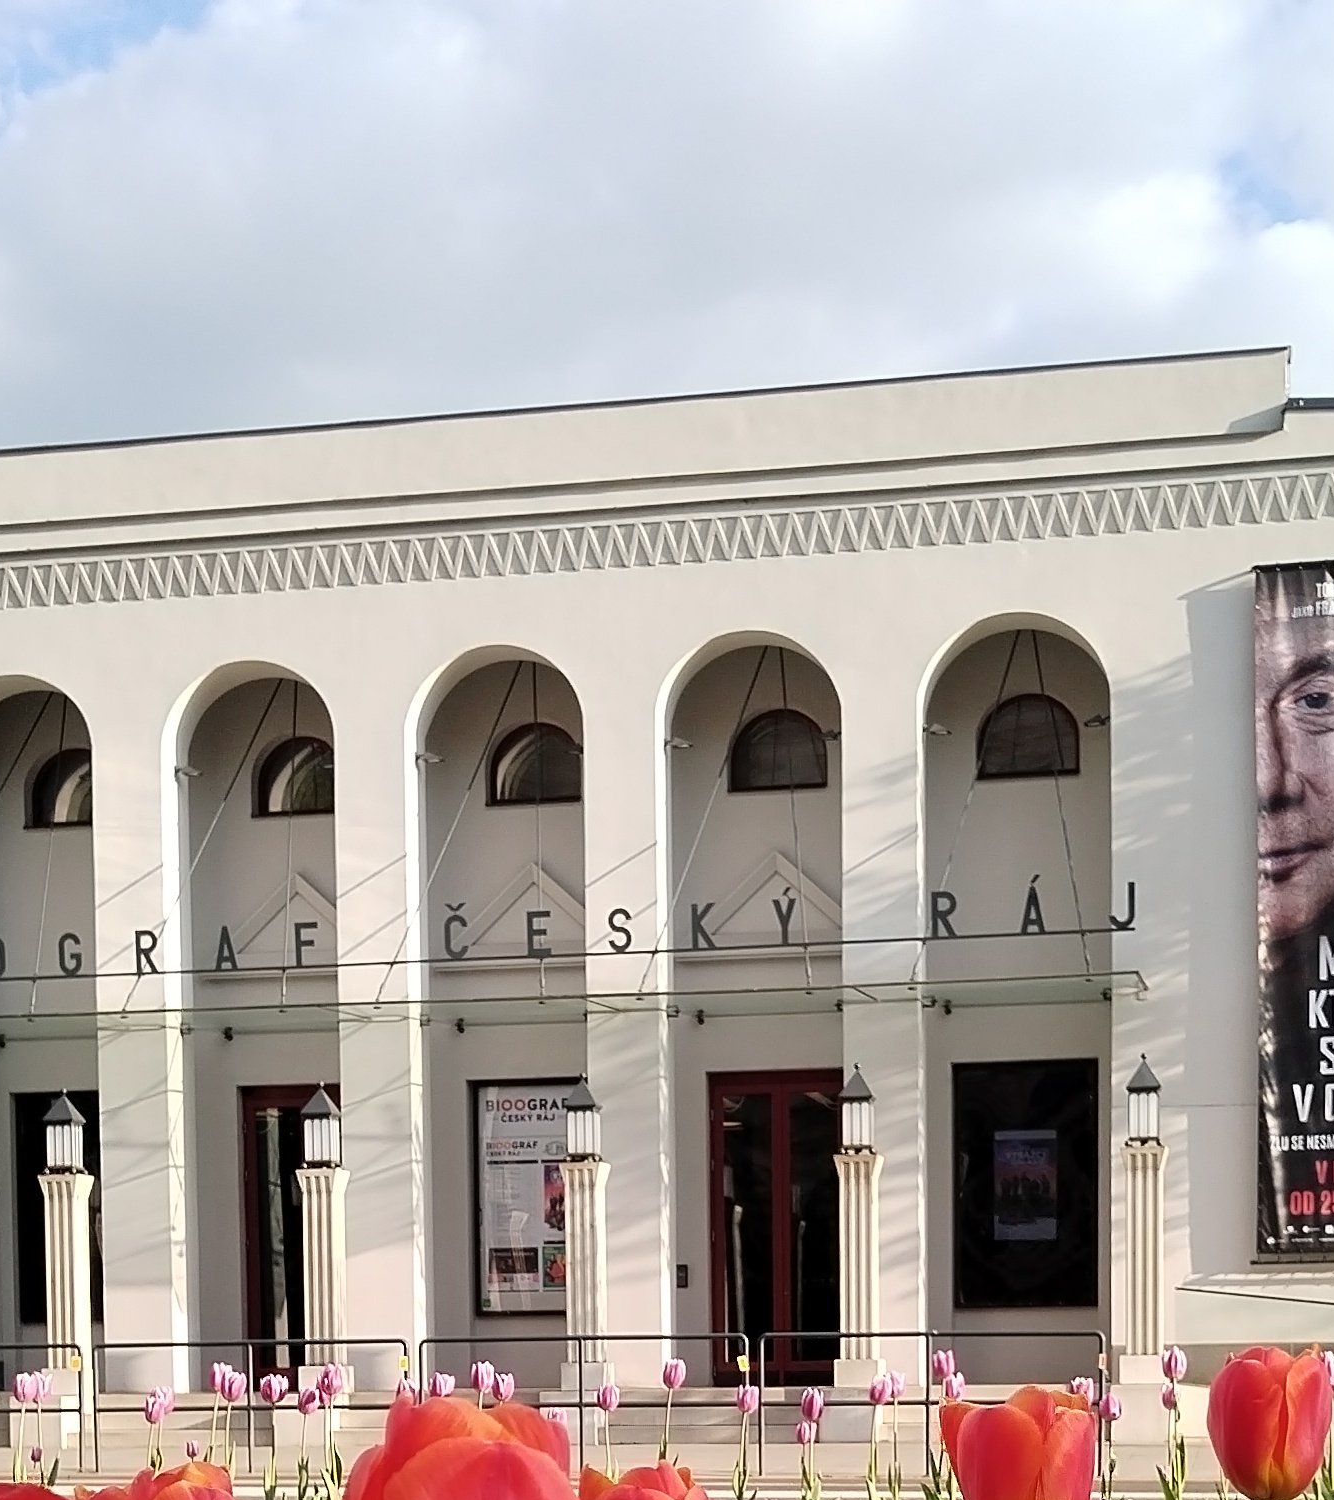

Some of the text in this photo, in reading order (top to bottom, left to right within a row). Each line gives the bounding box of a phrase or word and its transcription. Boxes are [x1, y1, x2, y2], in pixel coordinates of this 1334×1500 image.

[444, 887, 797, 960] ČESKÝ
[930, 874, 1136, 939] RÁJ
[1292, 1083, 1314, 1123] V
[1290, 1134, 1305, 1151] SE
[1315, 1160, 1329, 1184] V
[1289, 1190, 1315, 1216] OD
